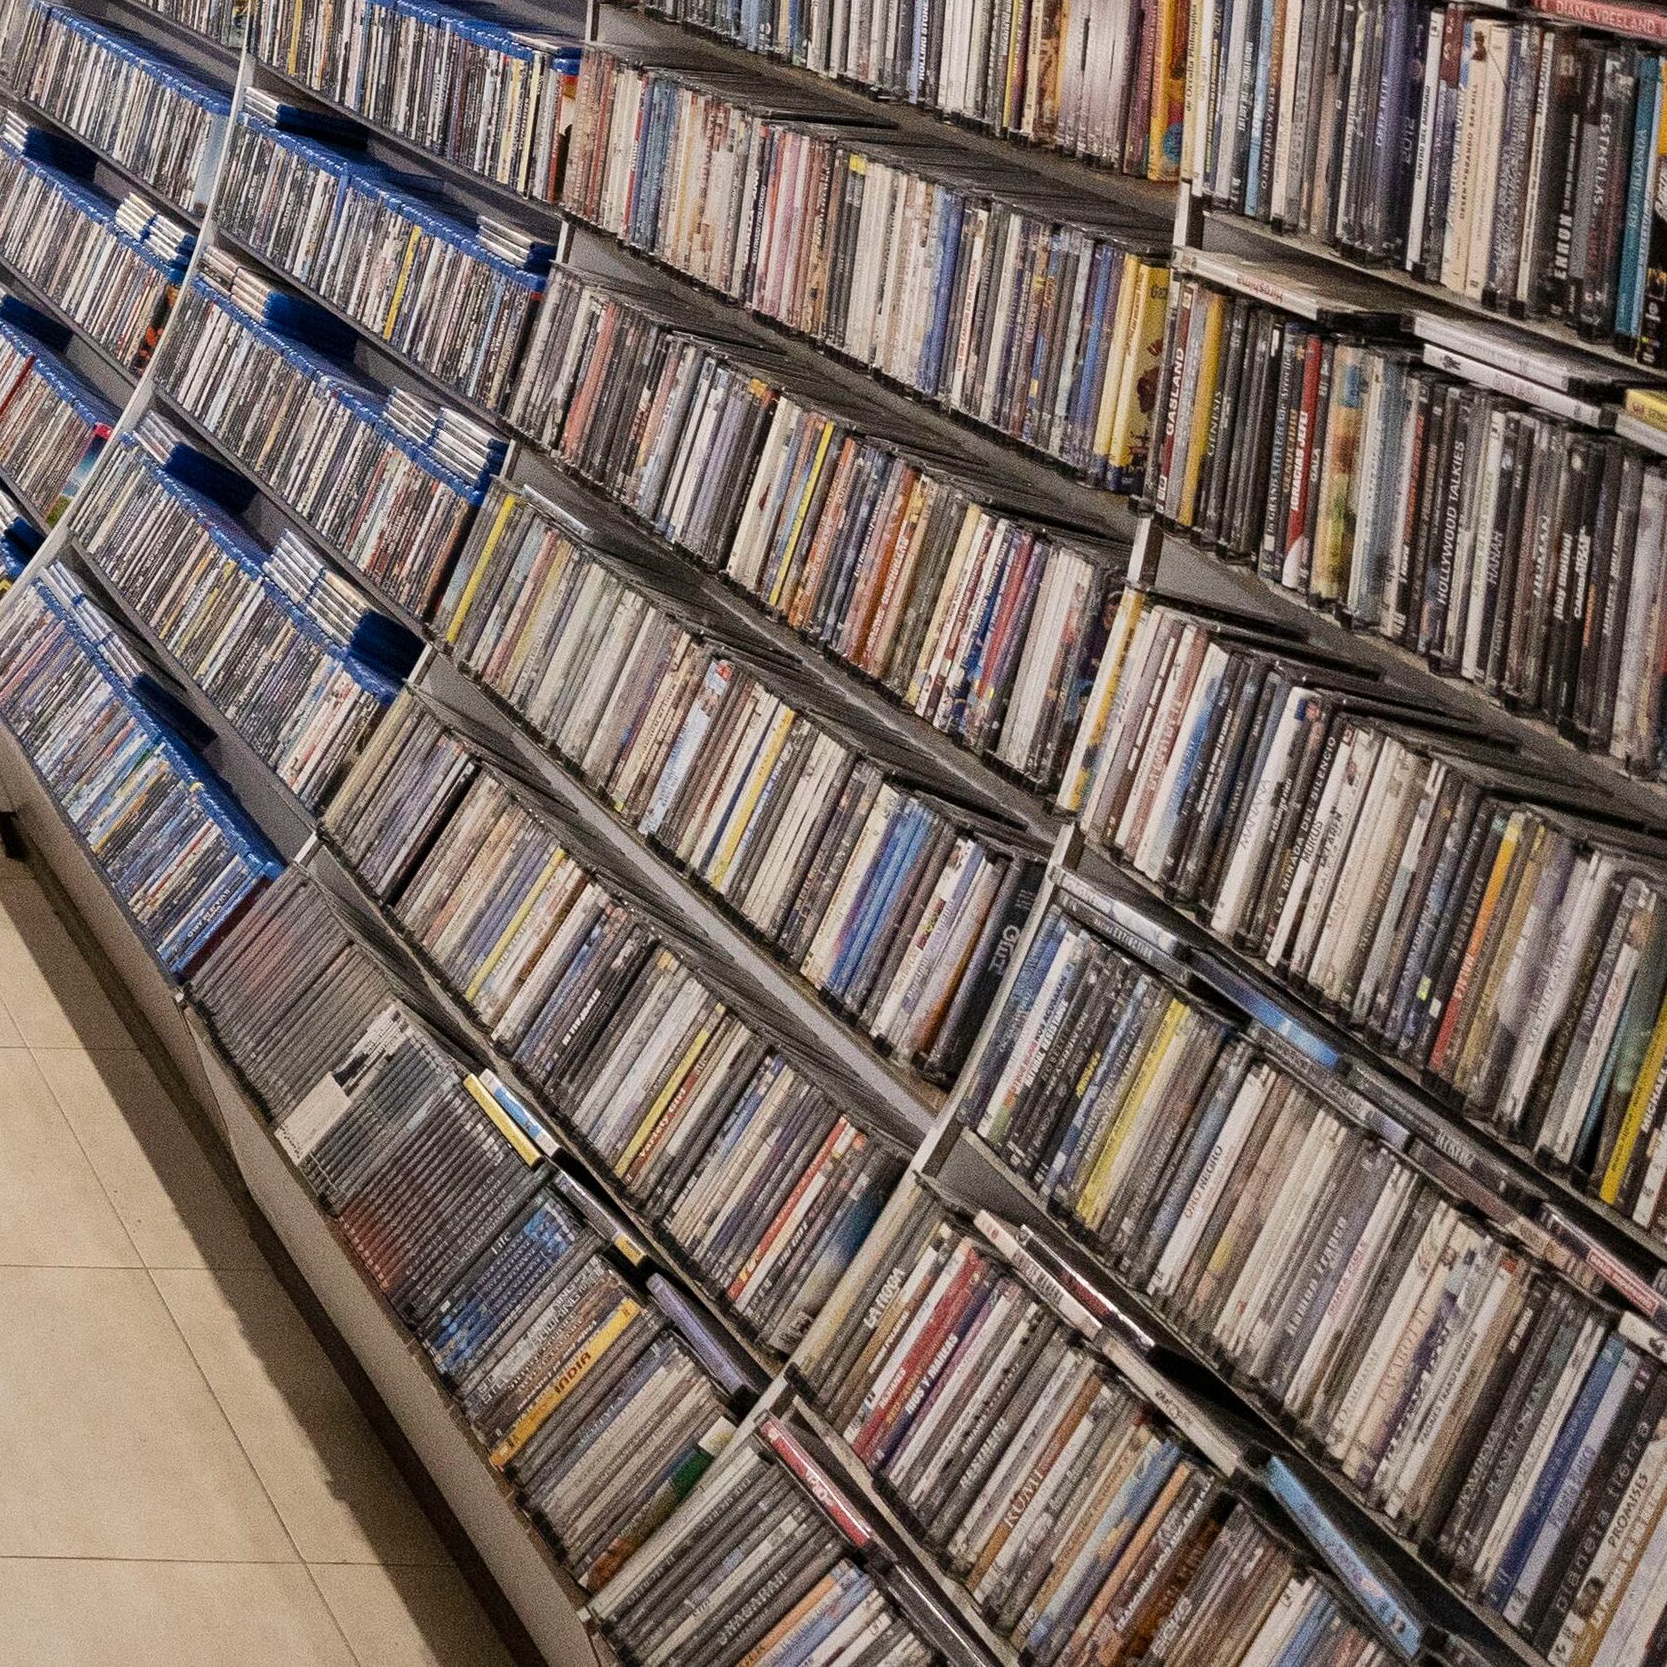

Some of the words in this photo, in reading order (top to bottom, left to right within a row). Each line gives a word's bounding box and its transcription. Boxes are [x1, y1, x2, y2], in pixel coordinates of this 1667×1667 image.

[1552, 211, 1573, 281] ENRON
[1444, 439, 1470, 503] TALKIES
[1430, 504, 1464, 605] HOLLYWOOD
